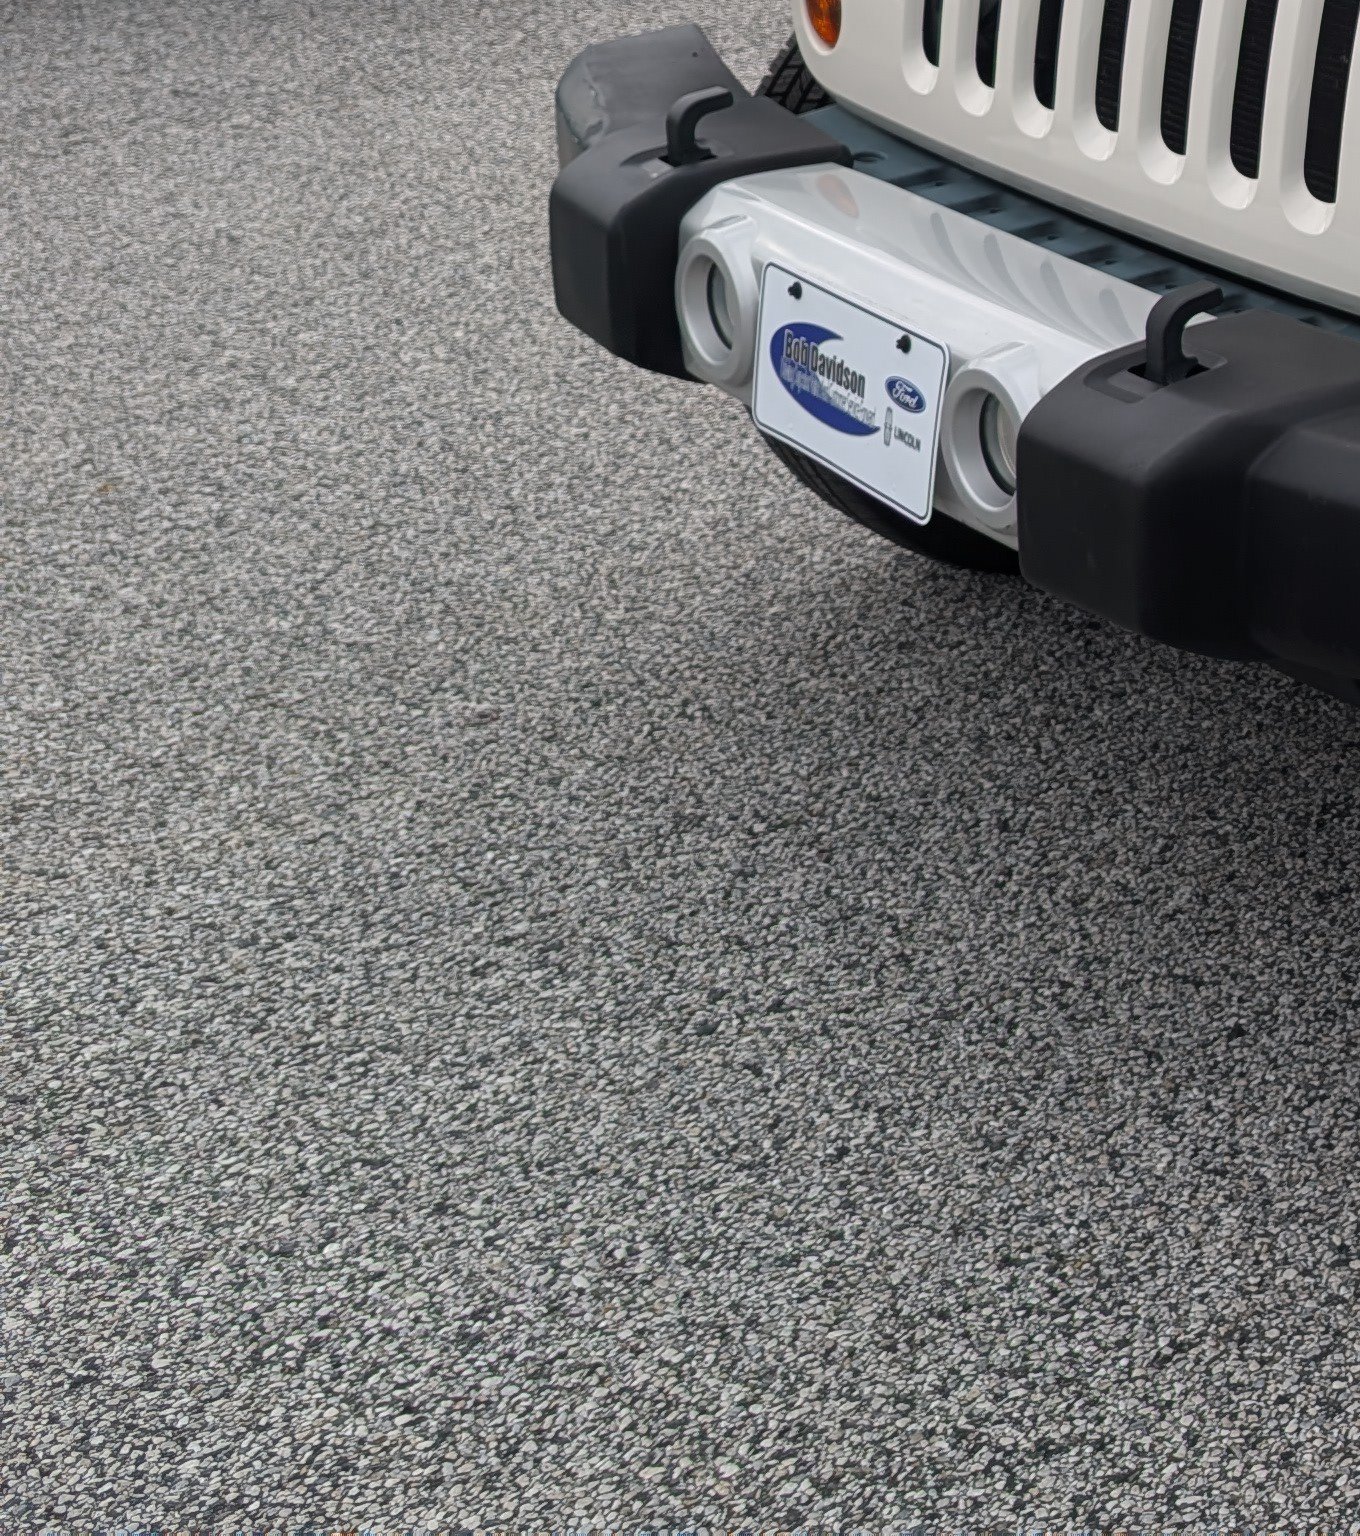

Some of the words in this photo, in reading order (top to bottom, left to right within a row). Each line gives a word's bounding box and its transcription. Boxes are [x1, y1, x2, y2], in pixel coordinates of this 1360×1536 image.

[785, 328, 810, 366] Bob
[810, 340, 866, 399] Davidson
[892, 380, 919, 408] Ford
[894, 426, 922, 452] LINCOLN
